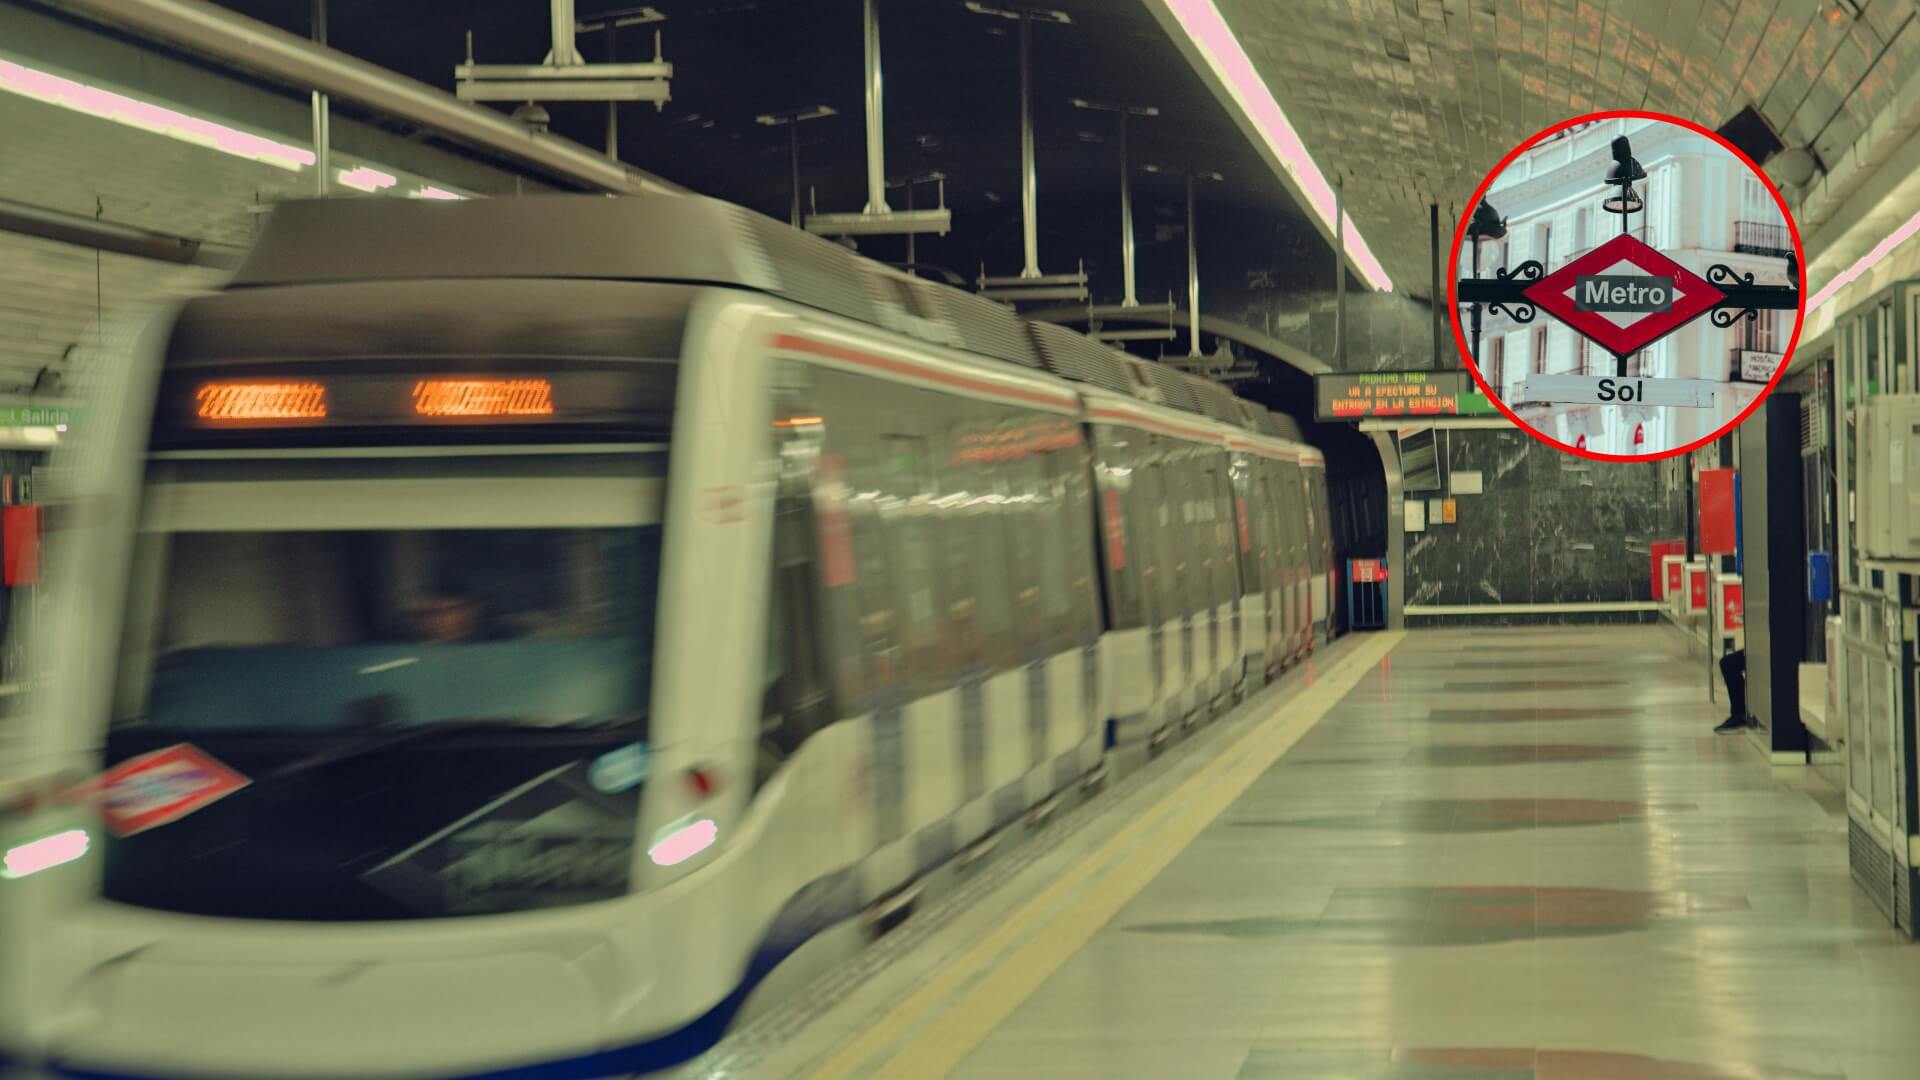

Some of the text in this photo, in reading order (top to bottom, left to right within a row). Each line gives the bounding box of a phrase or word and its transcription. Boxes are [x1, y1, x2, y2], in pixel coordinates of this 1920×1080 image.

[1585, 280, 1665, 305] Metro
[1404, 372, 1426, 384] TREN
[1348, 384, 1437, 397] VA A EFECTUAR SU
[1597, 378, 1643, 402] Sol
[1332, 399, 1372, 410] ENTRADA
[1376, 398, 1388, 409] EN
[1392, 397, 1404, 409] LA
